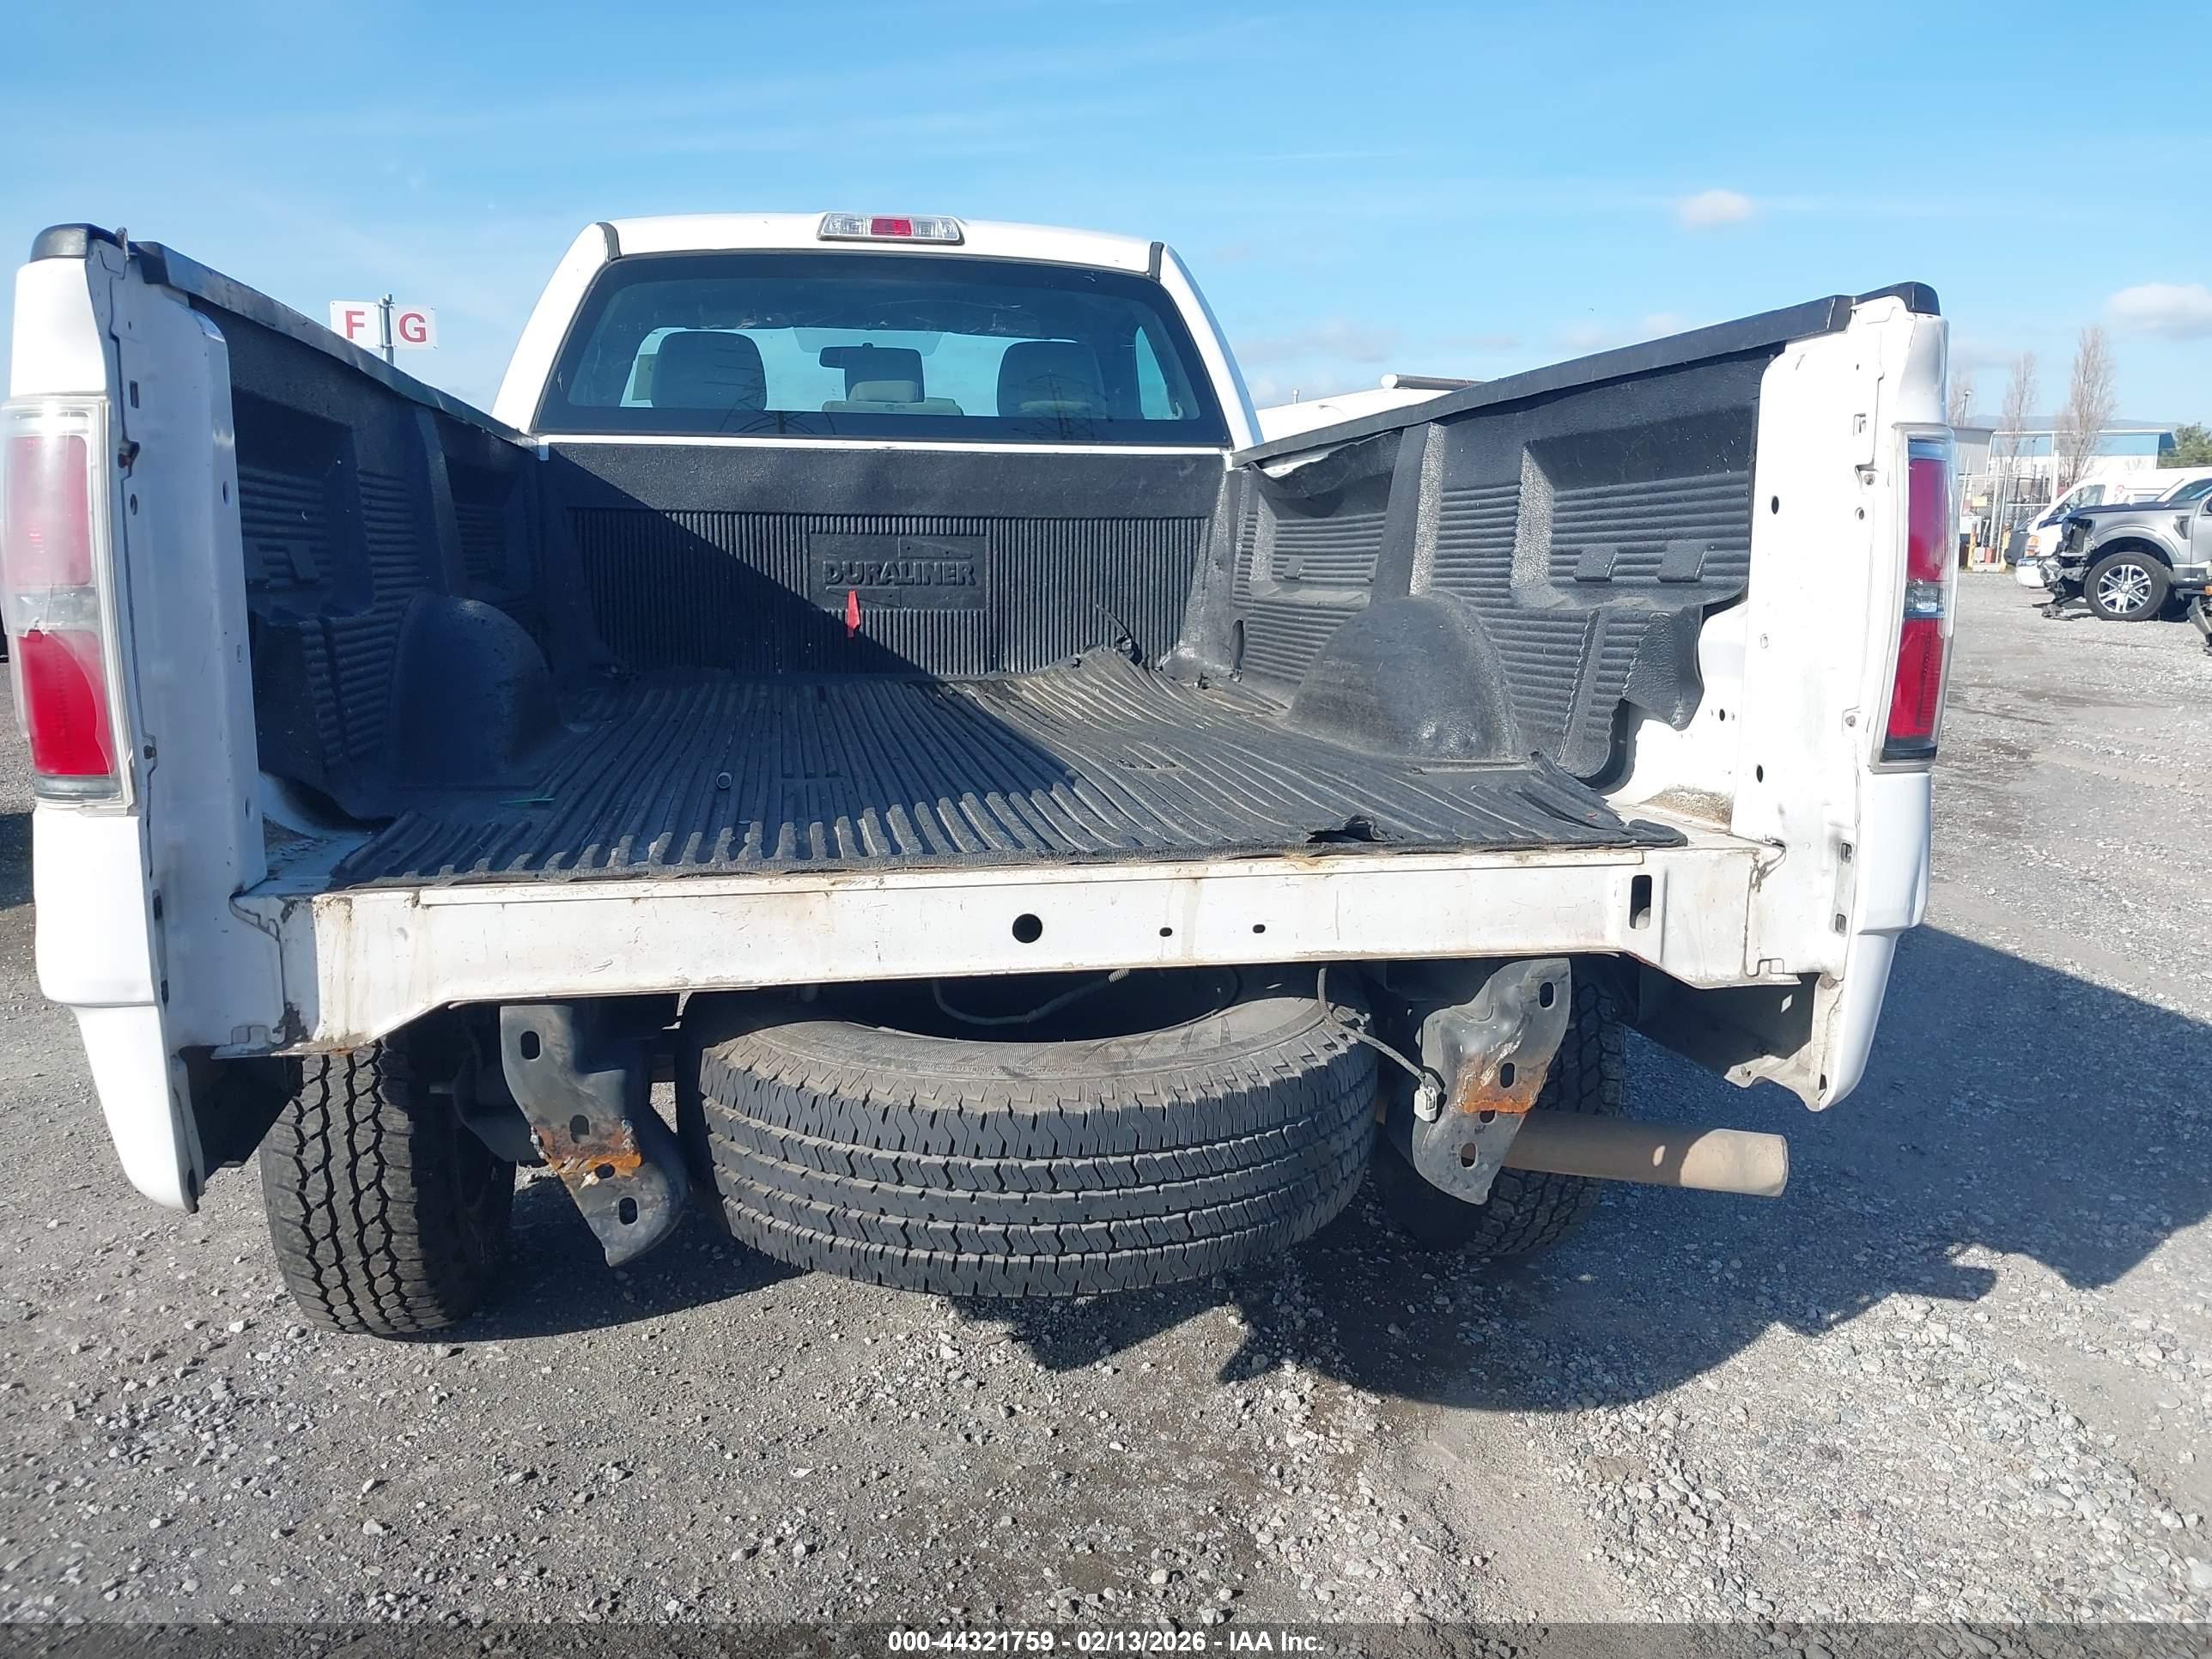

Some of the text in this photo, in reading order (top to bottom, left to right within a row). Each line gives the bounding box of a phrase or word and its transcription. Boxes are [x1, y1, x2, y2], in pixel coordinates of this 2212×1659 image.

[345, 310, 366, 340] F
[398, 312, 427, 343] G
[822, 560, 976, 586] DURALINER
